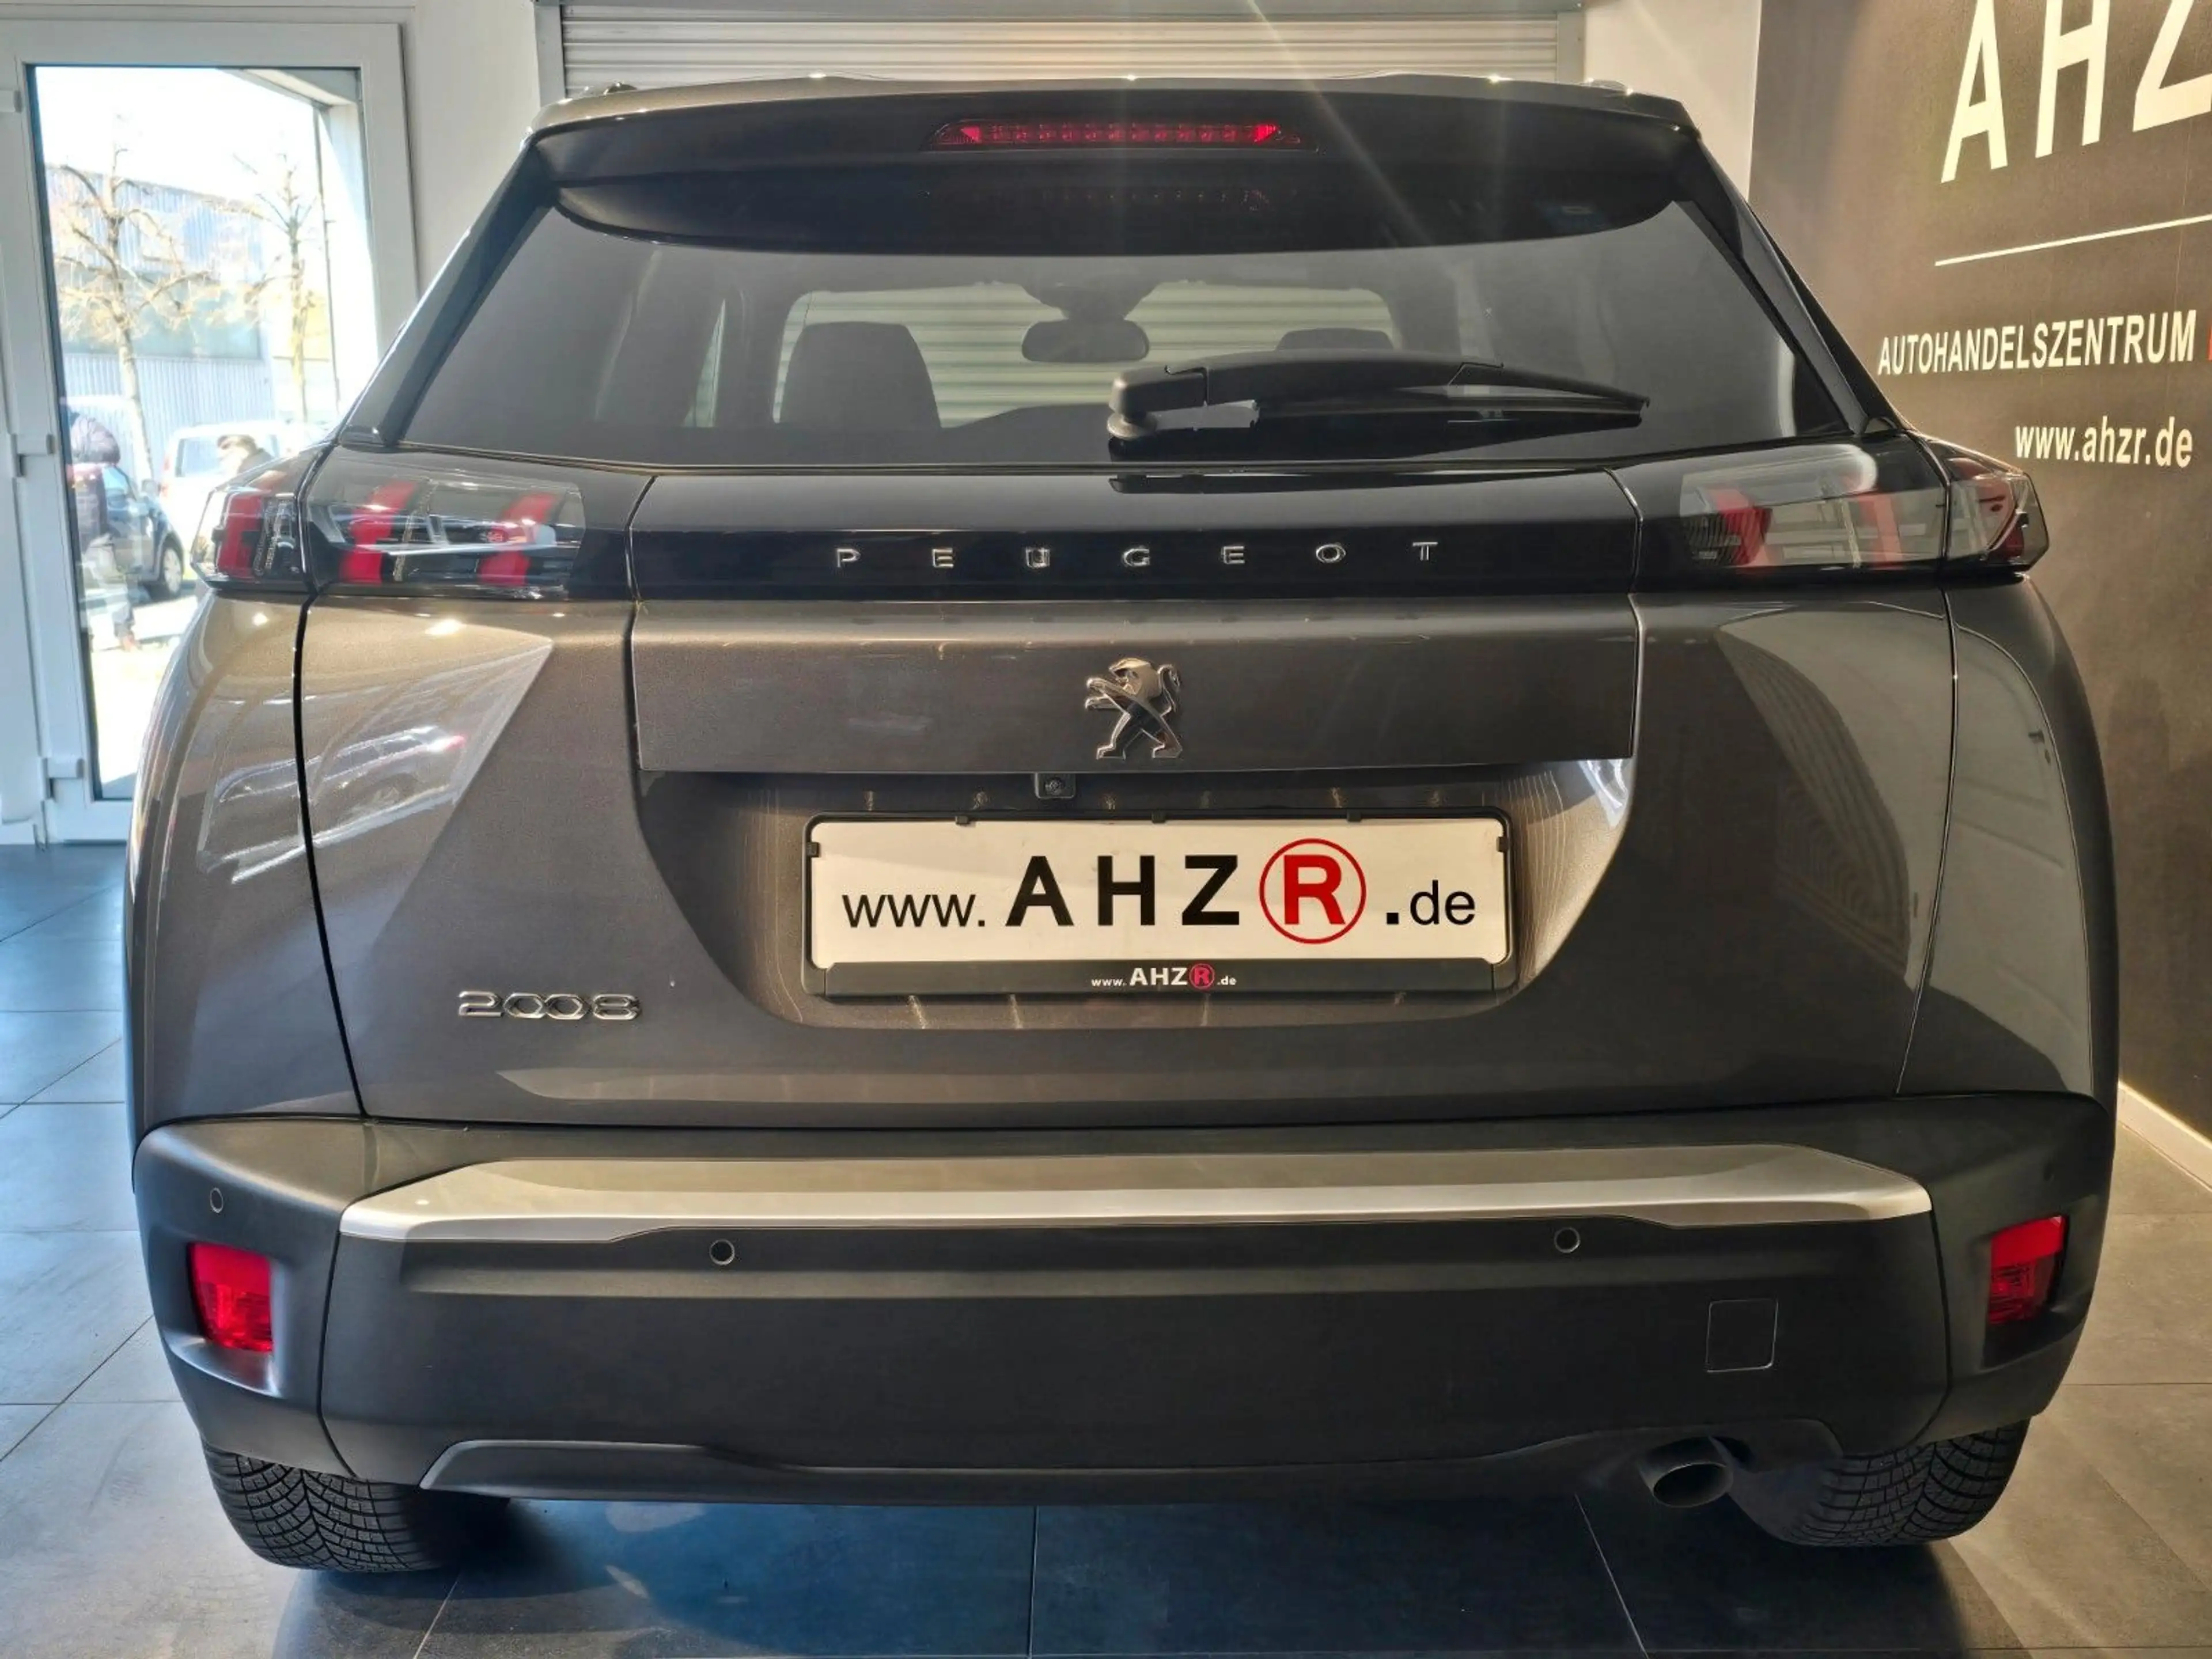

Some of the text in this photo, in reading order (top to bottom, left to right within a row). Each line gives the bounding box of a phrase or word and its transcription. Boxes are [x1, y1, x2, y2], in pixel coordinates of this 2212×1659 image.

[1877, 309, 2196, 376] AUTOHANDELSZENTRUM
[2015, 416, 2194, 468] www.ahzr.de
[835, 540, 1438, 569] PEUGEOT
[457, 990, 642, 1020] 2008
